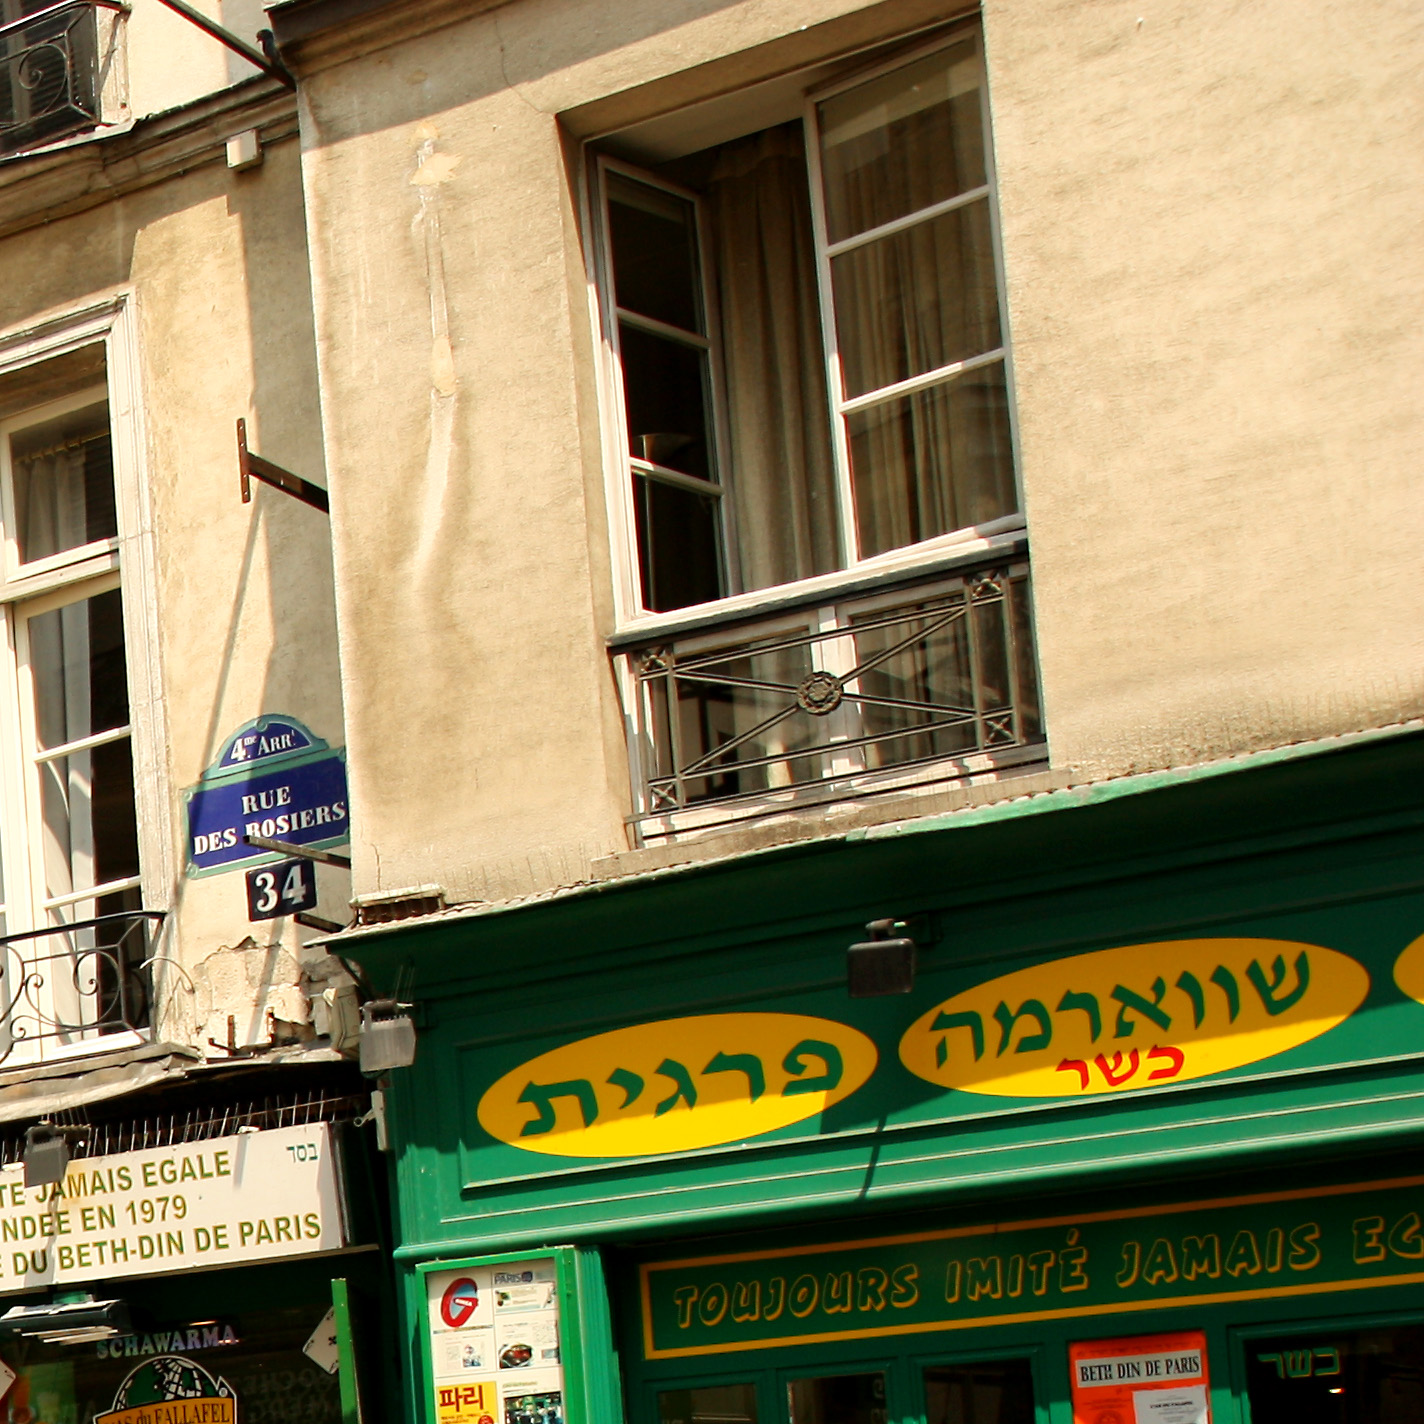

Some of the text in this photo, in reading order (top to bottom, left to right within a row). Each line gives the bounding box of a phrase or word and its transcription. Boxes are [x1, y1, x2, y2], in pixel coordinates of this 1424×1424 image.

[242, 786, 291, 814] RUE
[194, 801, 345, 855] DES ROSIERS
[255, 864, 307, 913] 34
[928, 950, 1311, 1071] שווארמה
[518, 1037, 845, 1137] פרגית
[1056, 1044, 1186, 1091] כשר
[34, 1165, 133, 1203] JAMAIS
[142, 1150, 232, 1187] EGALE
[83, 1205, 115, 1232] EN
[124, 1195, 188, 1226] 1979
[13, 1247, 48, 1273] DU
[54, 1232, 187, 1270] BETH-DIN
[196, 1225, 230, 1250] DE
[239, 1212, 322, 1243] PARIS
[674, 1262, 919, 1329] TOUJOURS
[947, 1227, 1089, 1303] IMITÉ
[1115, 1221, 1322, 1288] JAMAIS
[97, 1325, 237, 1359] SCHAWARMA
[1259, 1347, 1341, 1379] כשר
[1081, 1356, 1199, 1381] BETH DIN DE PARIS
[439, 1384, 484, 1412] 파리
